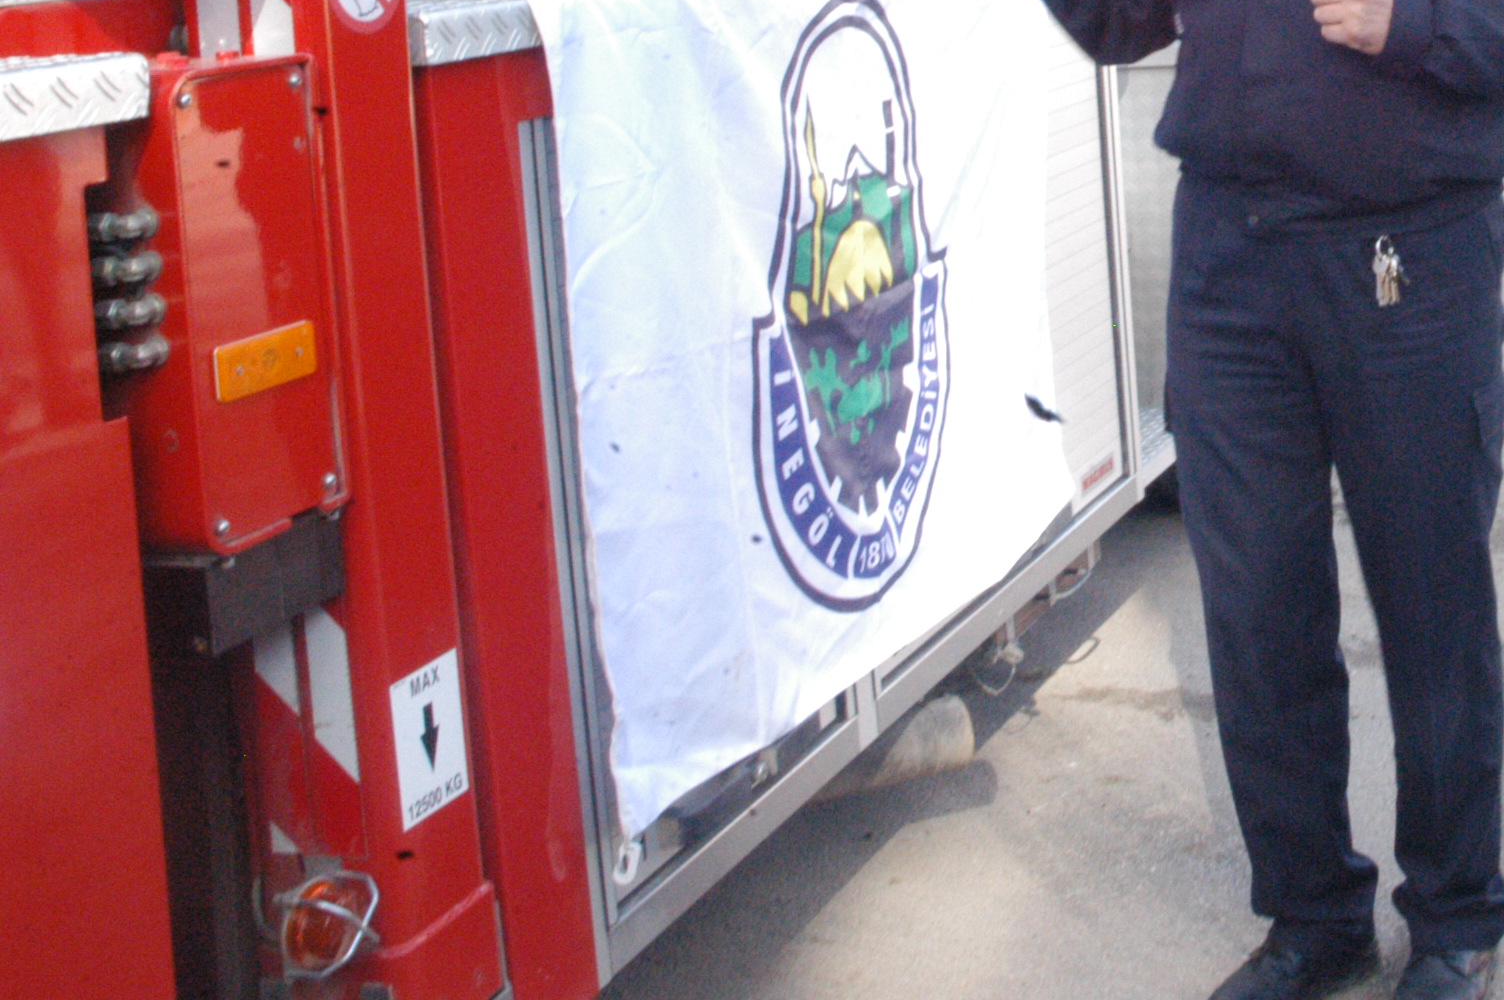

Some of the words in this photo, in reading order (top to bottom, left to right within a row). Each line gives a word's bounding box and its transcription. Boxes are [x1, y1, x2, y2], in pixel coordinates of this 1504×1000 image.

[774, 369, 843, 568] İNEGÖL
[893, 303, 938, 524] BELEDİYESİ
[410, 665, 440, 697] MAX
[408, 786, 442, 821] 12500
[445, 773, 463, 799] KG
